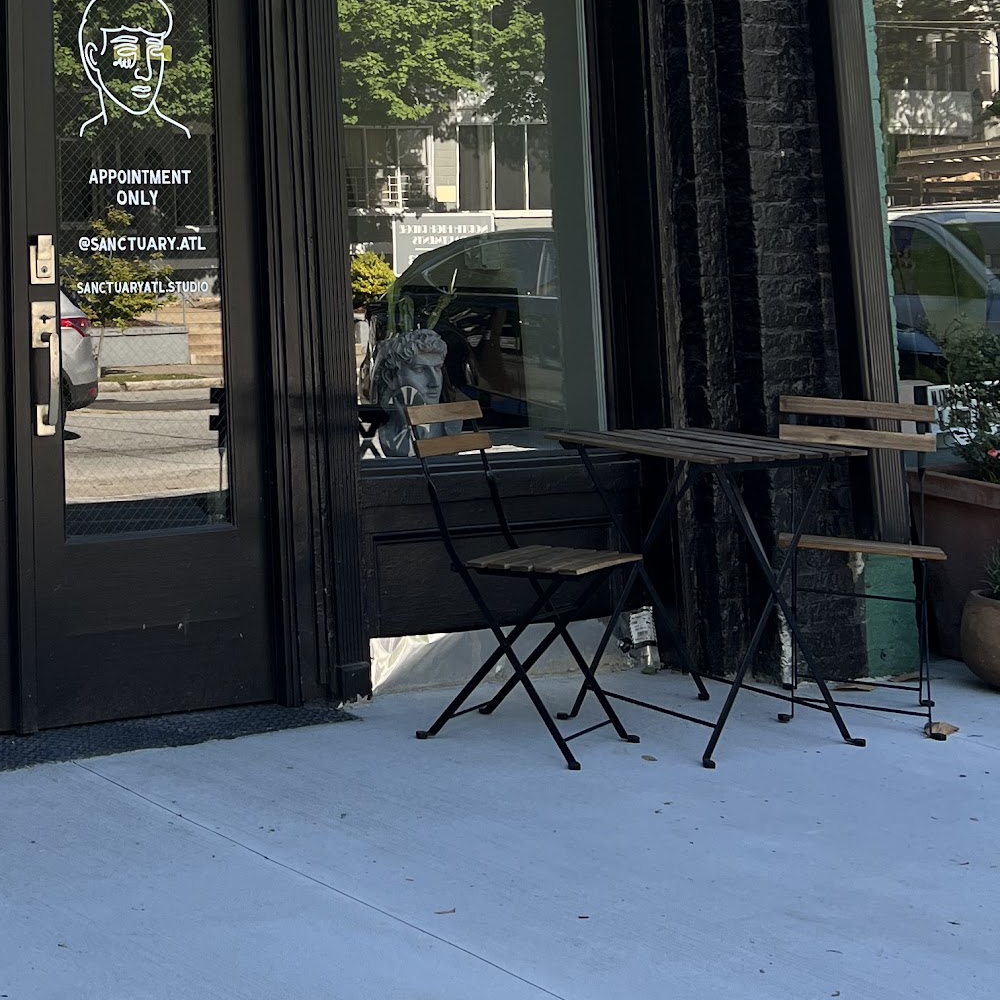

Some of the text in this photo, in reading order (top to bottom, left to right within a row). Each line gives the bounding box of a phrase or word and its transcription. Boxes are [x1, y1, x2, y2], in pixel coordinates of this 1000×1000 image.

[88, 168, 192, 185] APPOINTMENT
[116, 190, 159, 206] ONLY
[78, 236, 207, 251] @SANCTUARY.ATL
[76, 281, 209, 294] SANCTUARYATL.STUDIO
